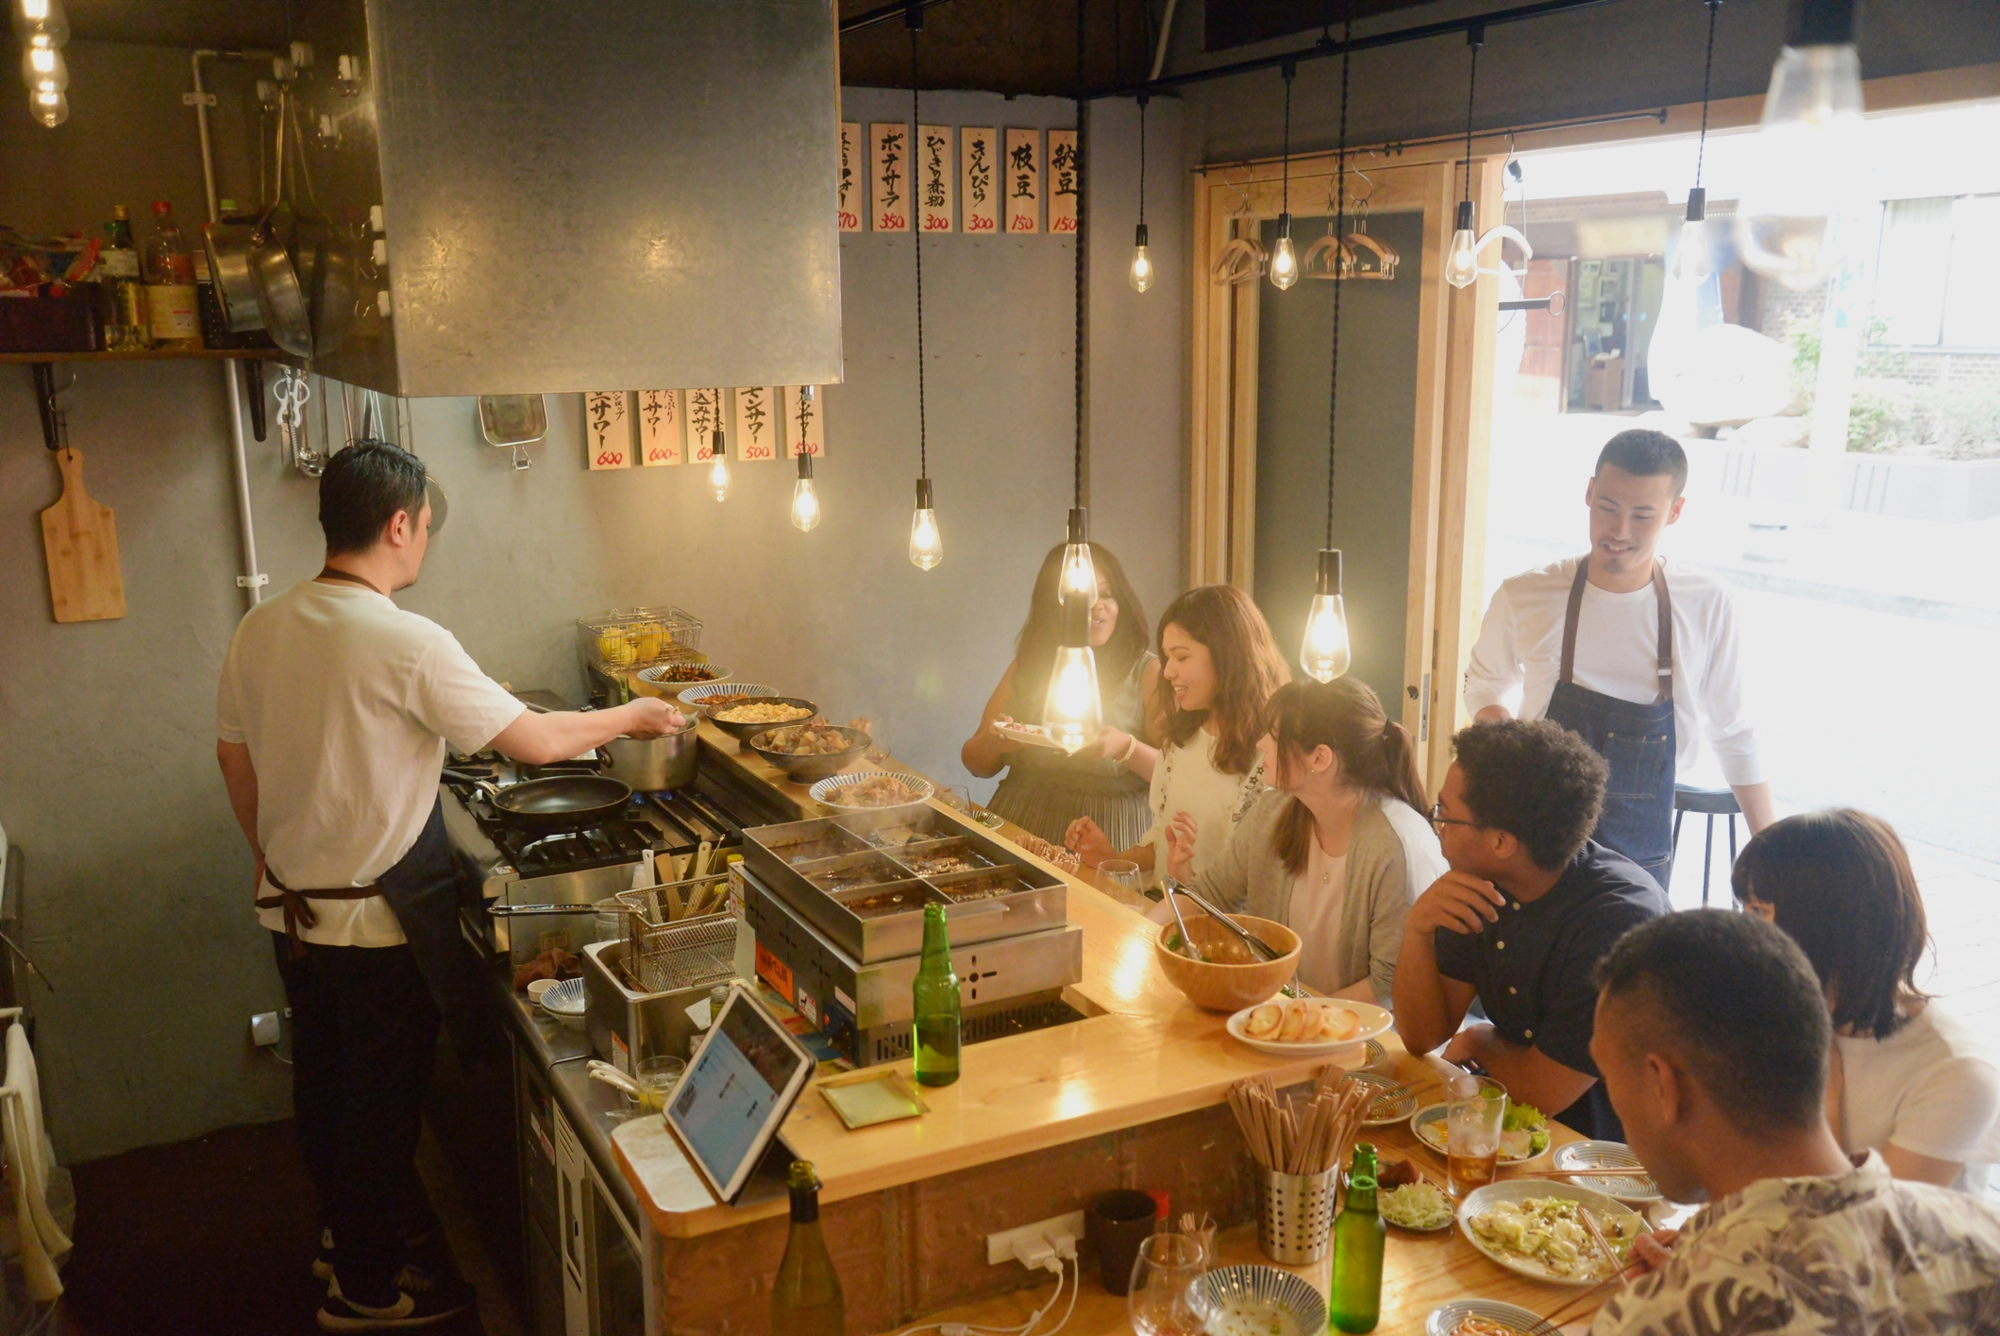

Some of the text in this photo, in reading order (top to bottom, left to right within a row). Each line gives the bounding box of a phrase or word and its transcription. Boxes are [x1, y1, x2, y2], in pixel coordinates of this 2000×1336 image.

[881, 133, 903, 208] ポテサラ
[924, 136, 946, 207] ひじきの煮物
[969, 139, 990, 208] きんぴら
[1011, 143, 1036, 200] 枝豆
[1051, 143, 1078, 196] 納豆
[879, 212, 905, 229] 350
[924, 214, 949, 230] 300
[968, 214, 994, 231] 300
[1011, 214, 1034, 231] 150
[1053, 216, 1078, 231] 150
[642, 390, 663, 438] りサワー
[691, 388, 712, 445] 込みサワー
[597, 451, 623, 466] 600
[745, 445, 770, 459] 500
